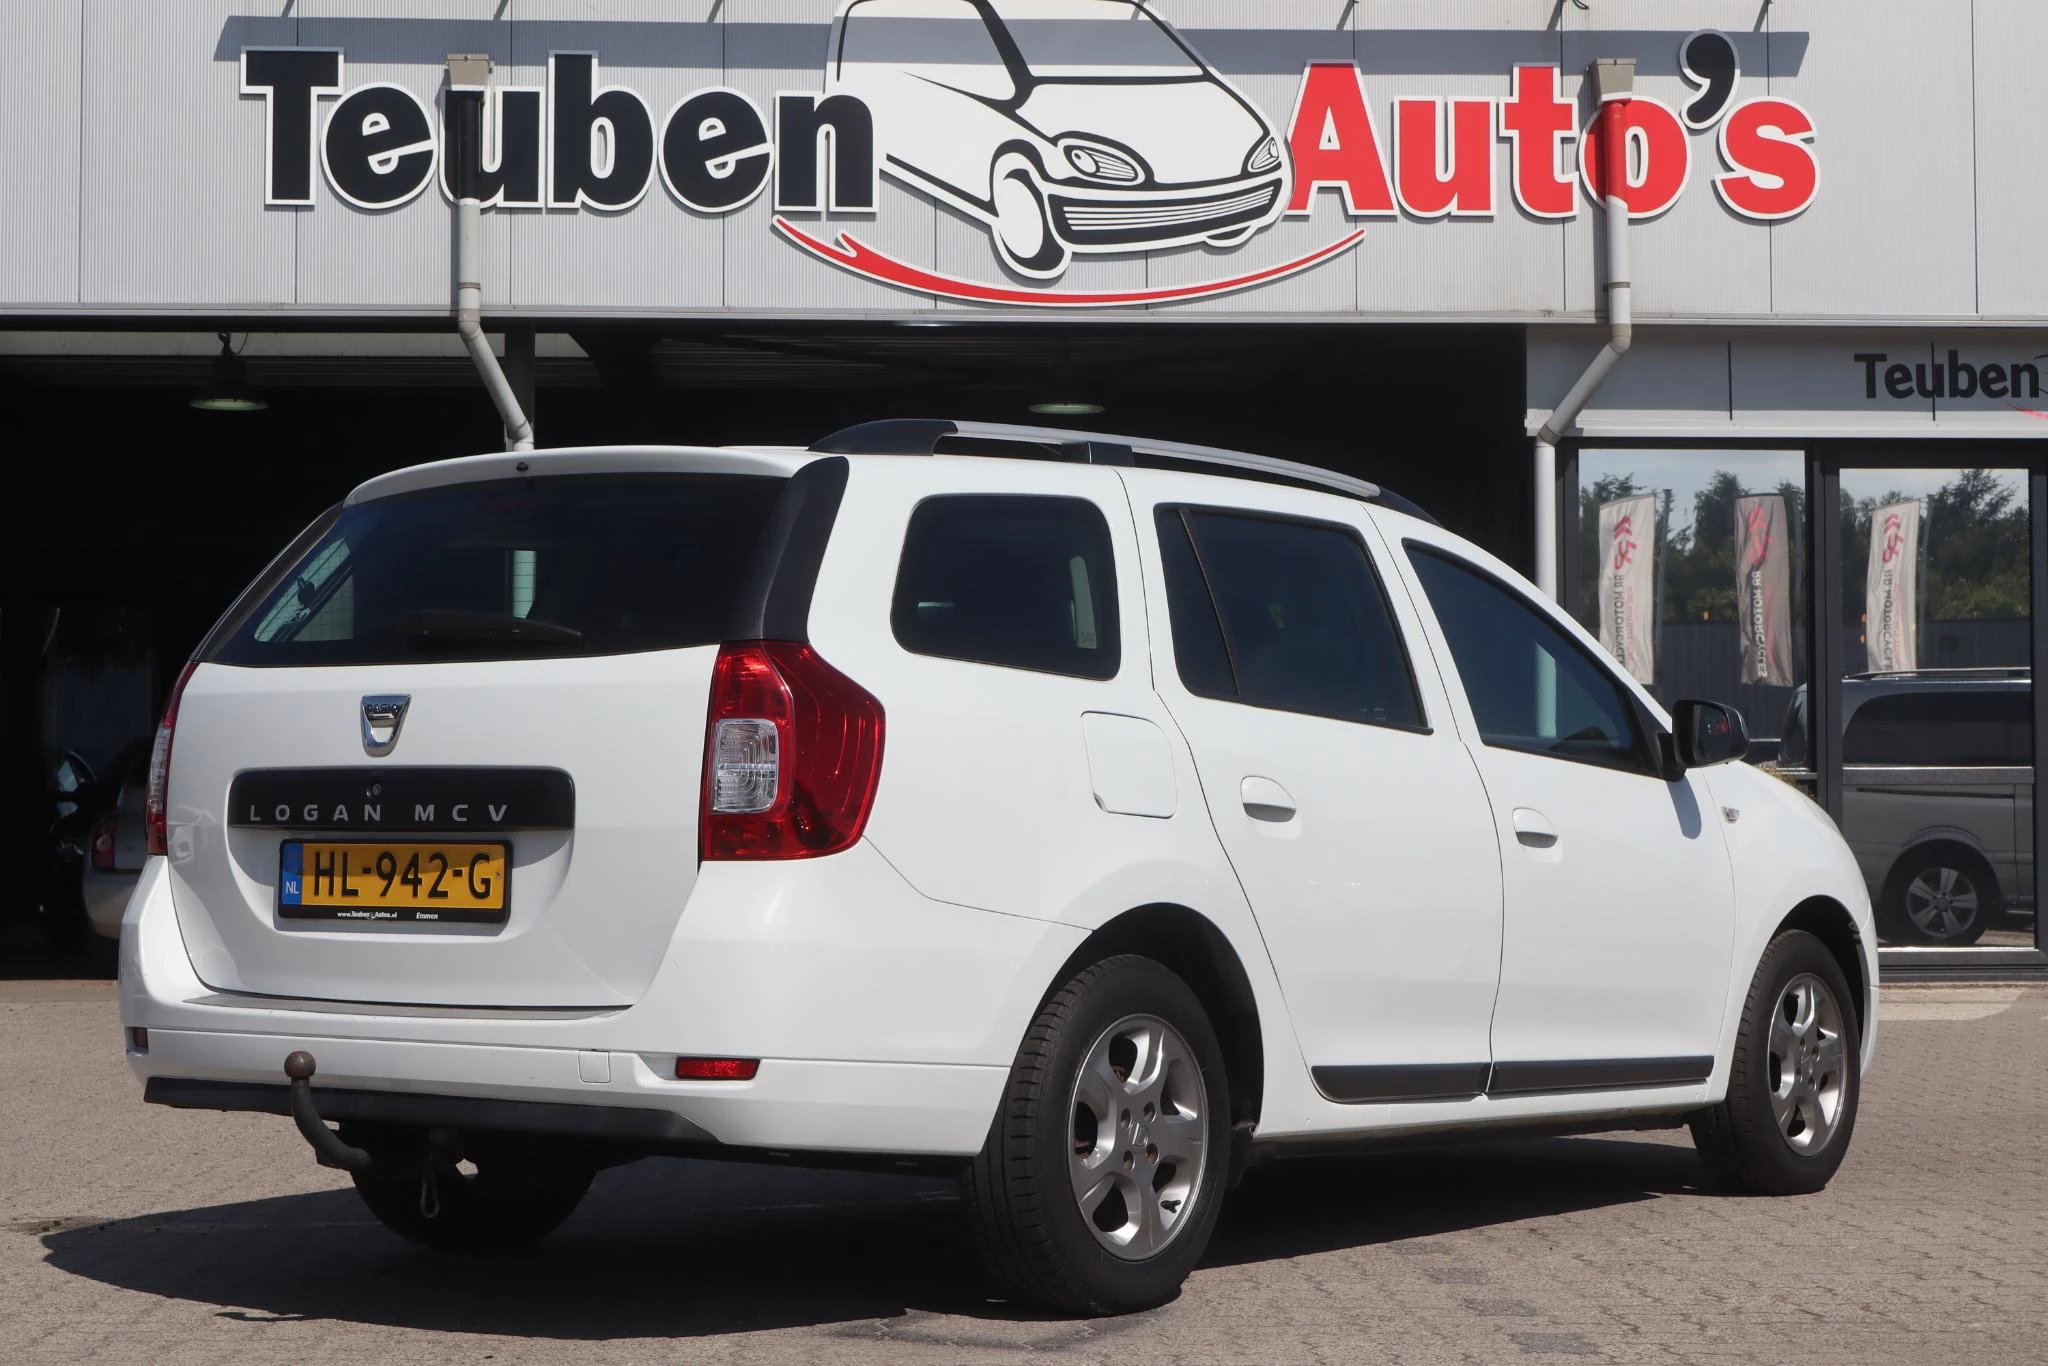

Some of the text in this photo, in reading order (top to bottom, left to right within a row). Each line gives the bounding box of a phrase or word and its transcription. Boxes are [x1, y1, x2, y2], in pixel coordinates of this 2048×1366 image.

[241, 29, 1820, 220] Teuben Auto's
[1854, 350, 2039, 399] Teuben
[250, 804, 381, 822] LOGAN
[285, 881, 299, 895] NL
[314, 851, 492, 900] HL-942-G
